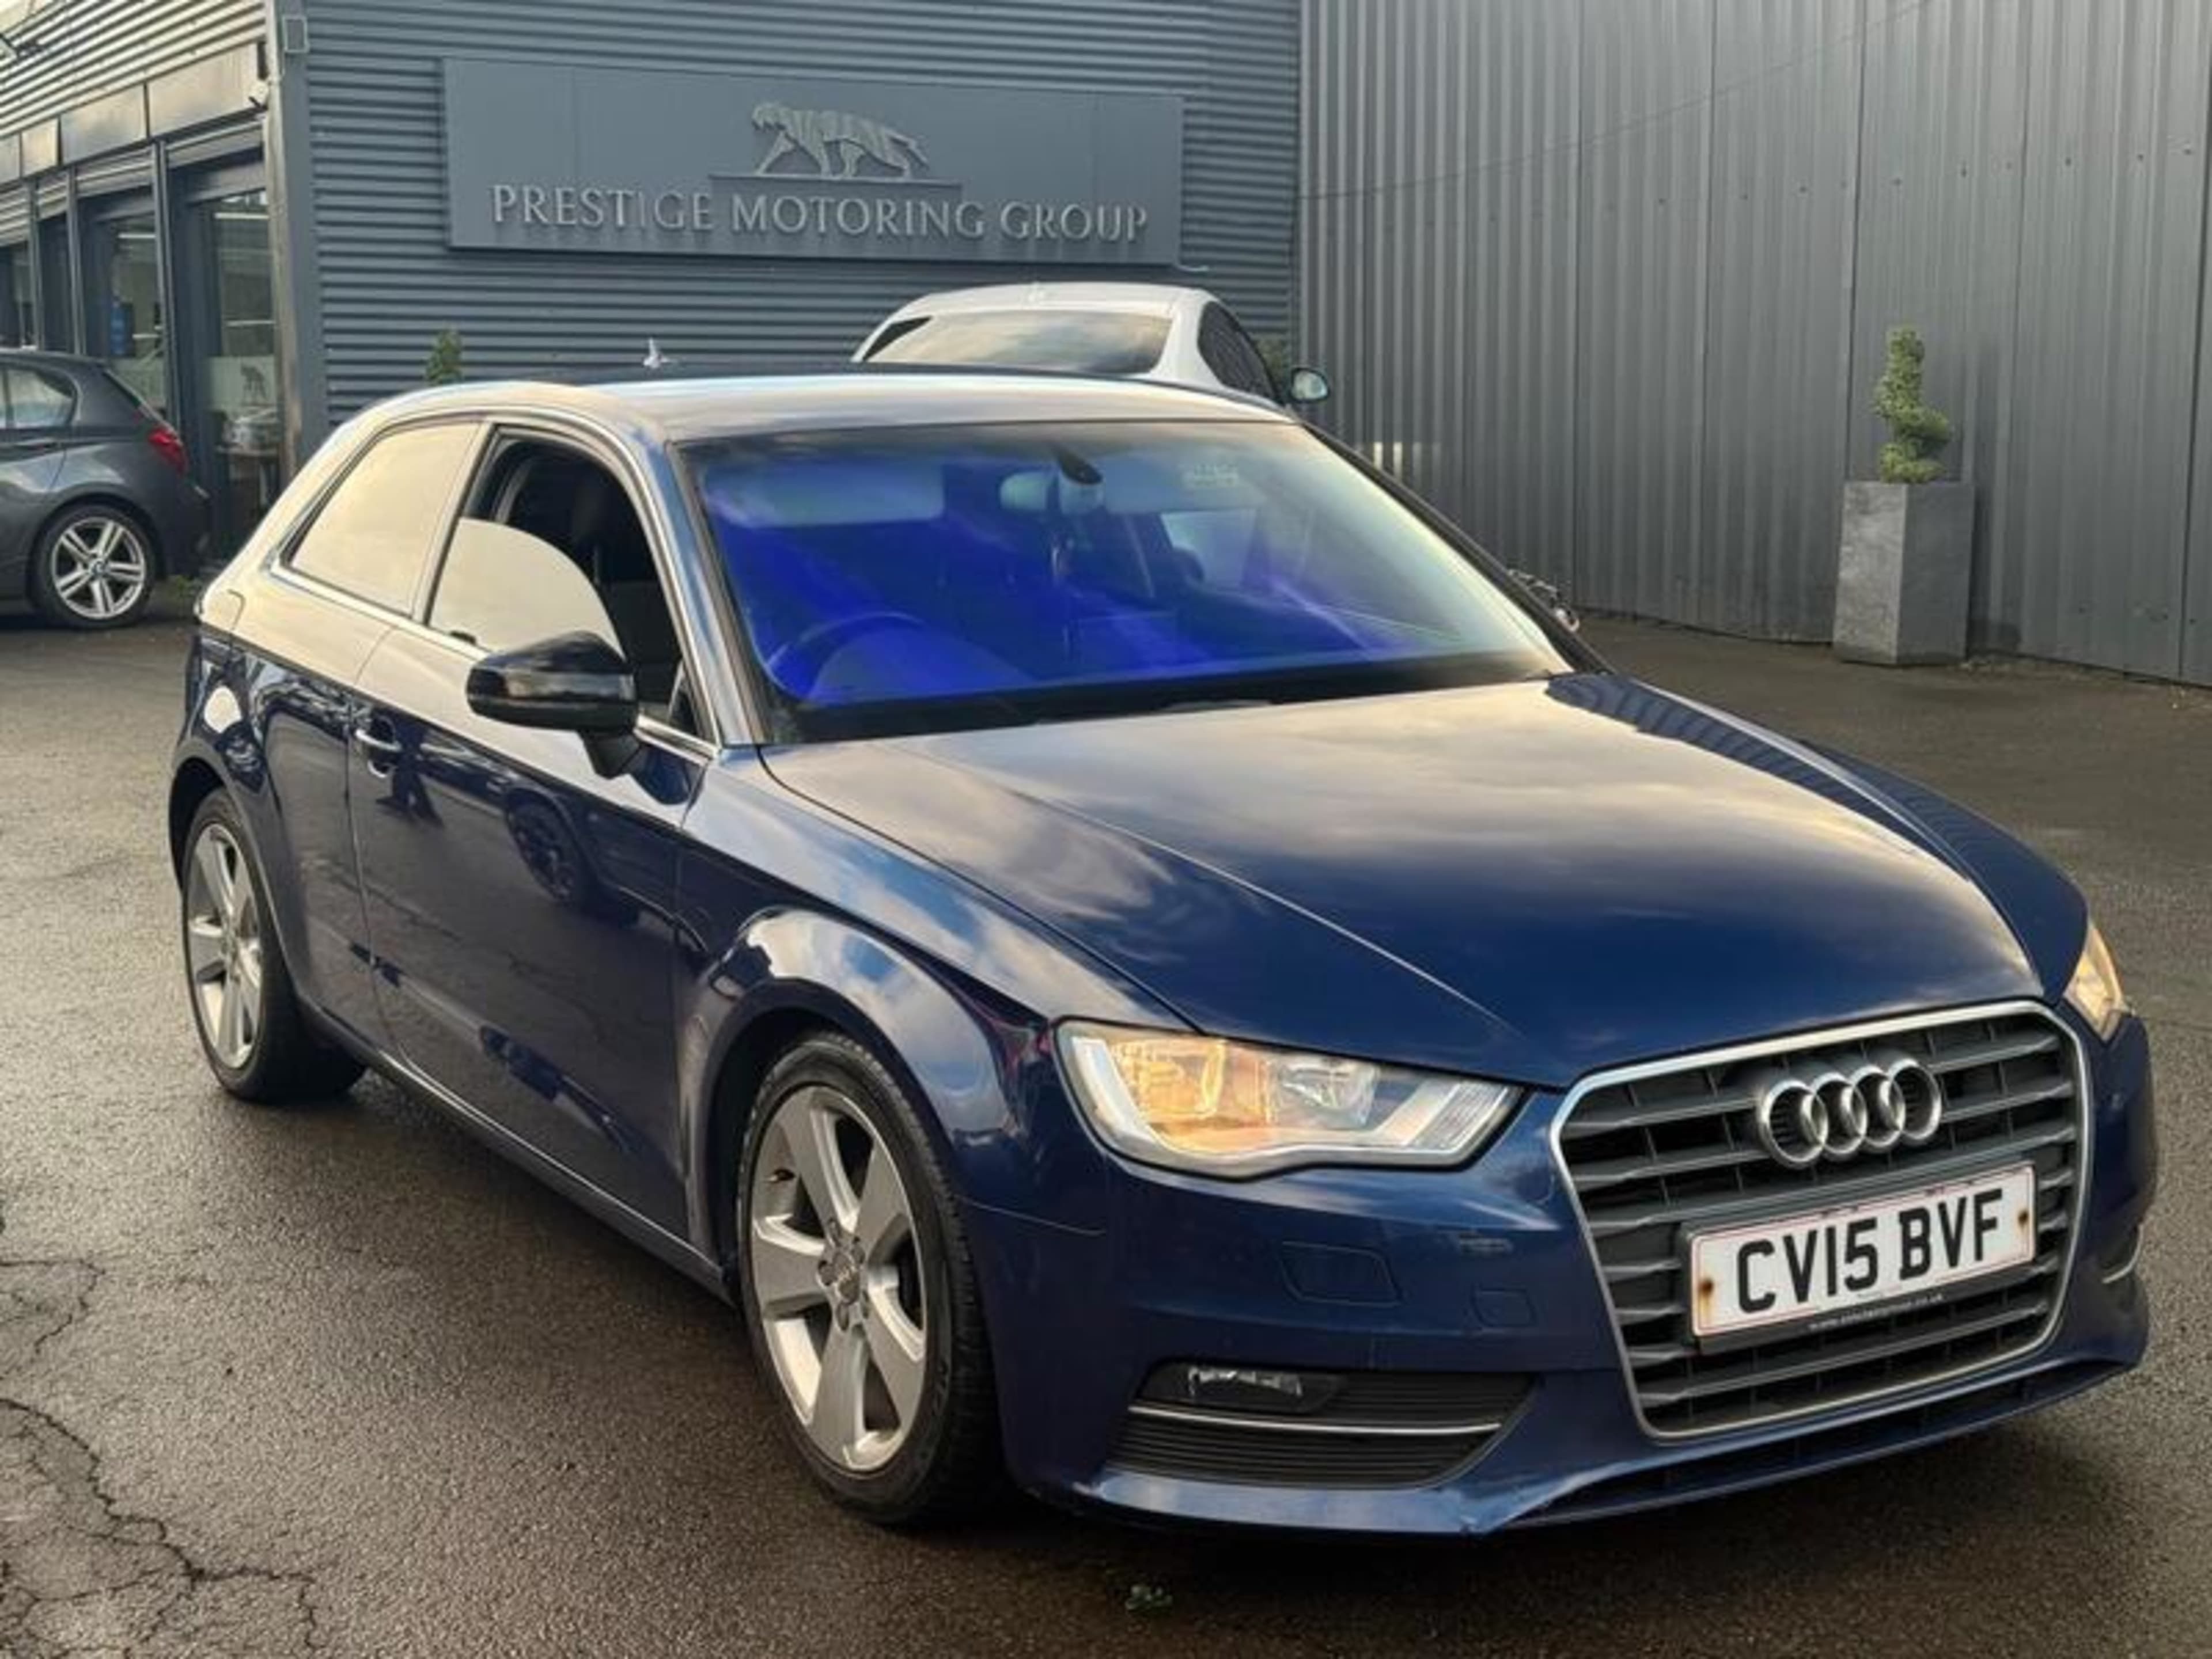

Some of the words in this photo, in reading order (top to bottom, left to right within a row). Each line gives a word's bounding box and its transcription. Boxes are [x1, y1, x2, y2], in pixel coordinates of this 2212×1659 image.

[493, 184, 714, 230] PRESTIGE
[731, 194, 984, 238] MOTORING
[999, 200, 1147, 241] GROUP
[1737, 1217, 1879, 1313] CV15
[1899, 1188, 2003, 1281] BVF
